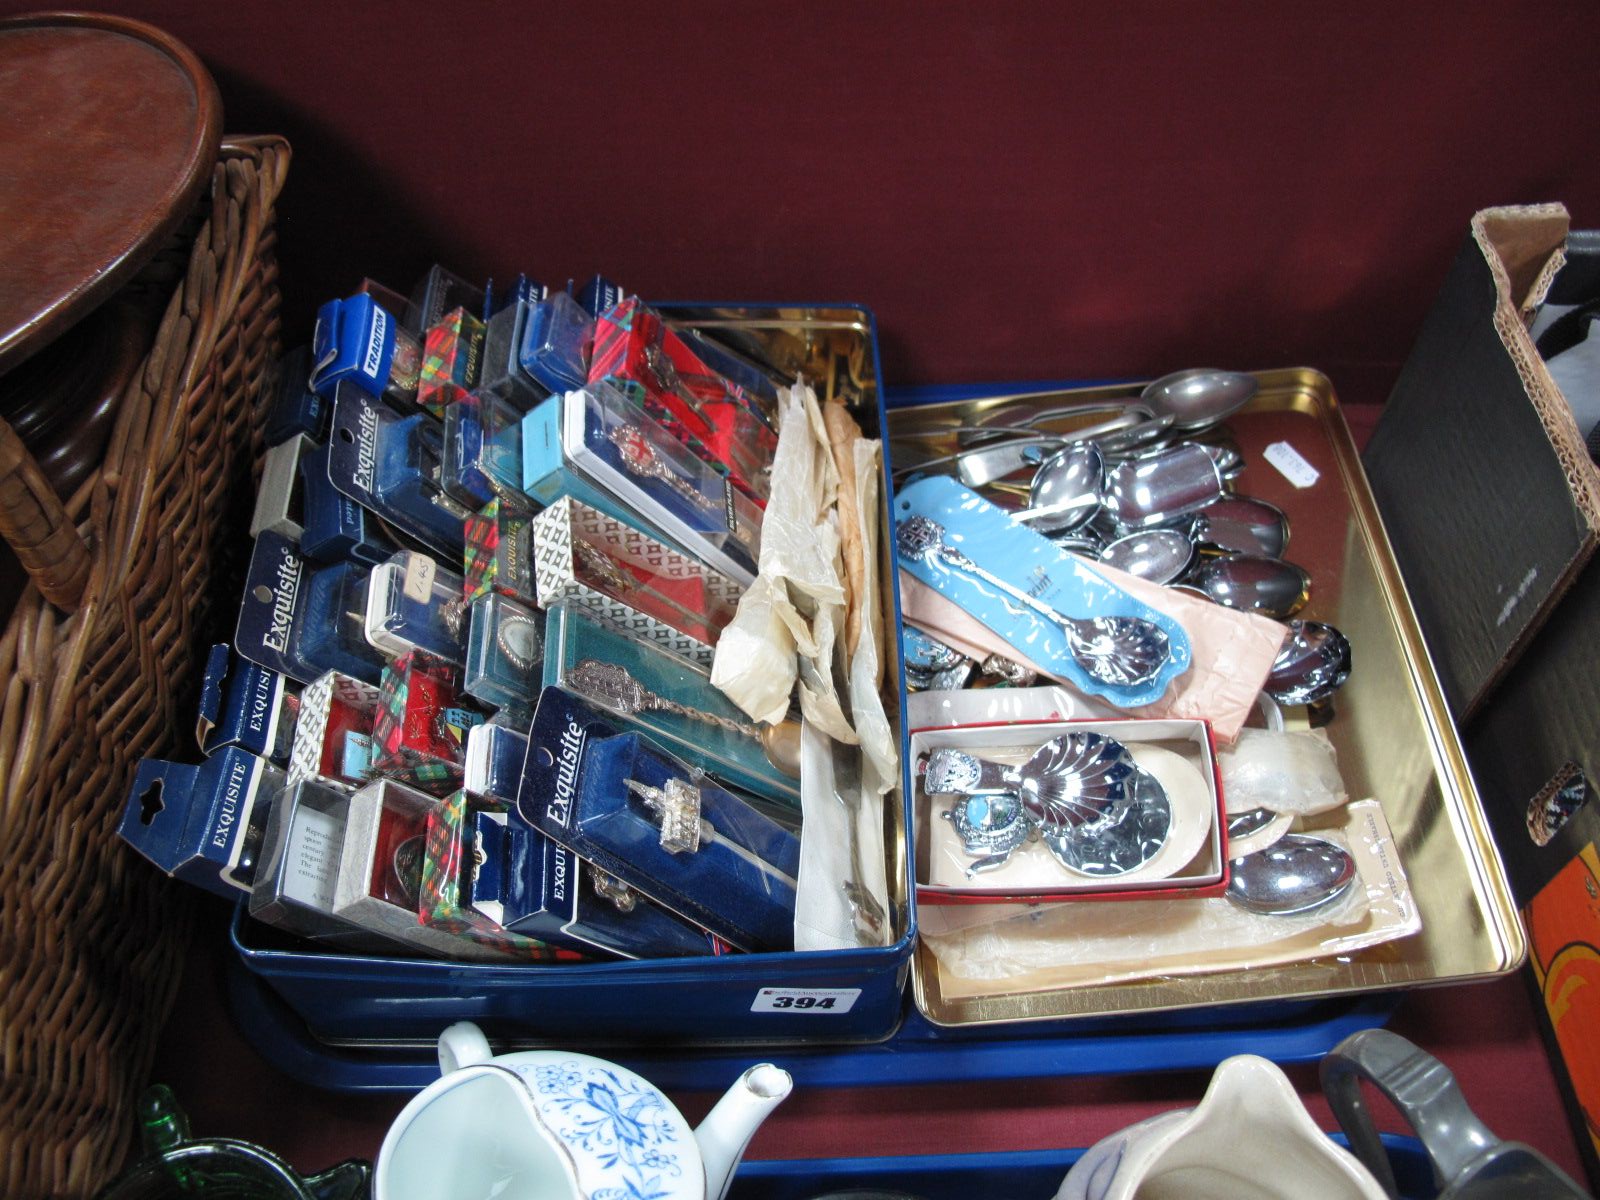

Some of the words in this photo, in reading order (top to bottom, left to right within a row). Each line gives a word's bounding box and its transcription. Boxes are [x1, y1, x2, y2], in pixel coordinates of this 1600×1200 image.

[367, 311, 384, 371] TRADITION
[250, 670, 271, 732] EXQUISI
[773, 997, 837, 1009] 394
